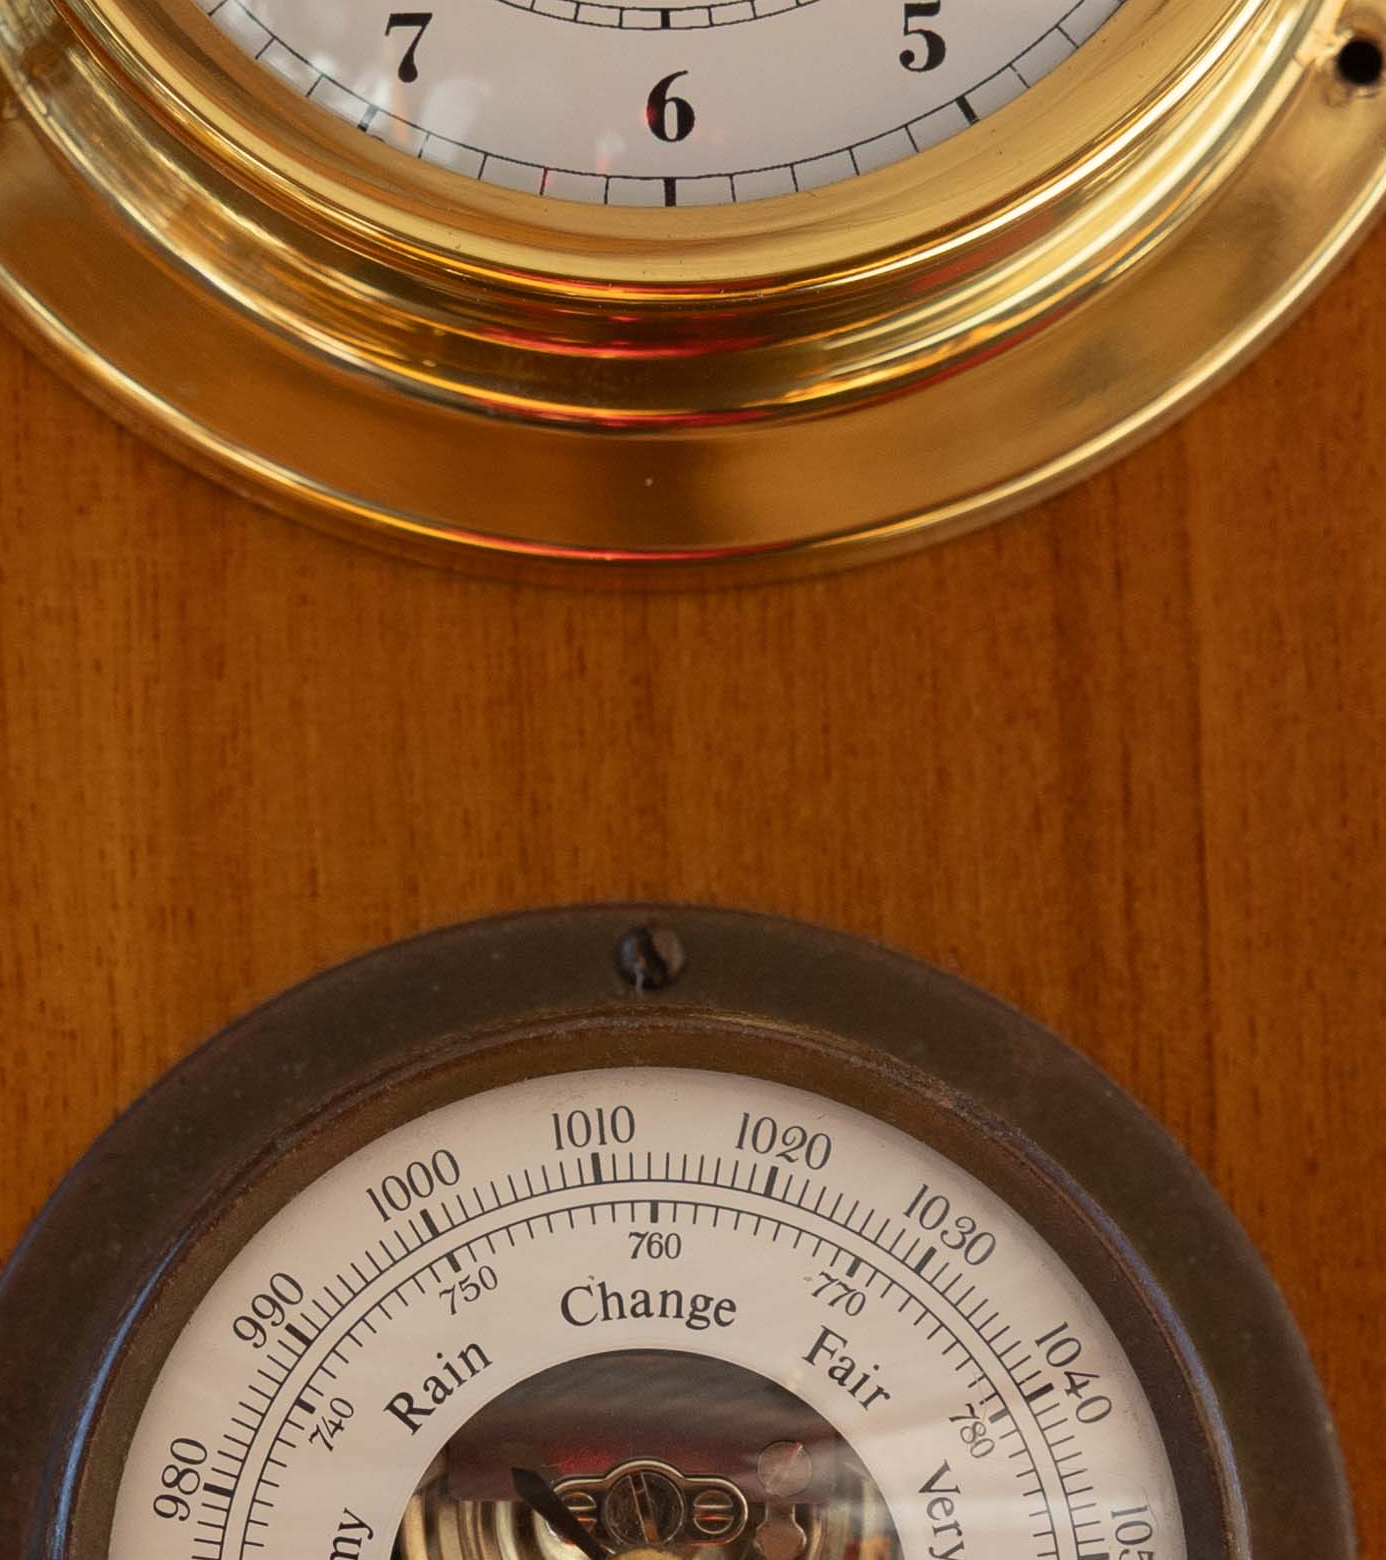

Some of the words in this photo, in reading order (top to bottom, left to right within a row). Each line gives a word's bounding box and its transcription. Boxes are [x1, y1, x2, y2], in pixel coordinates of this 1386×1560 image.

[385, 12, 432, 84] 7
[899, 0, 946, 73] 5
[646, 70, 696, 145] 6
[550, 1105, 636, 1151] 1010
[734, 1110, 834, 1171] 1020
[365, 1148, 462, 1224] 1000
[627, 1231, 683, 1261] 760
[901, 1182, 999, 1268] 1030
[230, 1272, 307, 1351] 990
[438, 1264, 501, 1317] 750
[559, 1281, 738, 1333] Change
[809, 1269, 868, 1318] 770
[384, 1336, 493, 1437] Rain
[802, 1326, 893, 1415] Fair
[1032, 1321, 1113, 1427] 1040
[307, 1396, 356, 1455] 740
[948, 1404, 997, 1460] 780
[151, 1437, 210, 1523] 980
